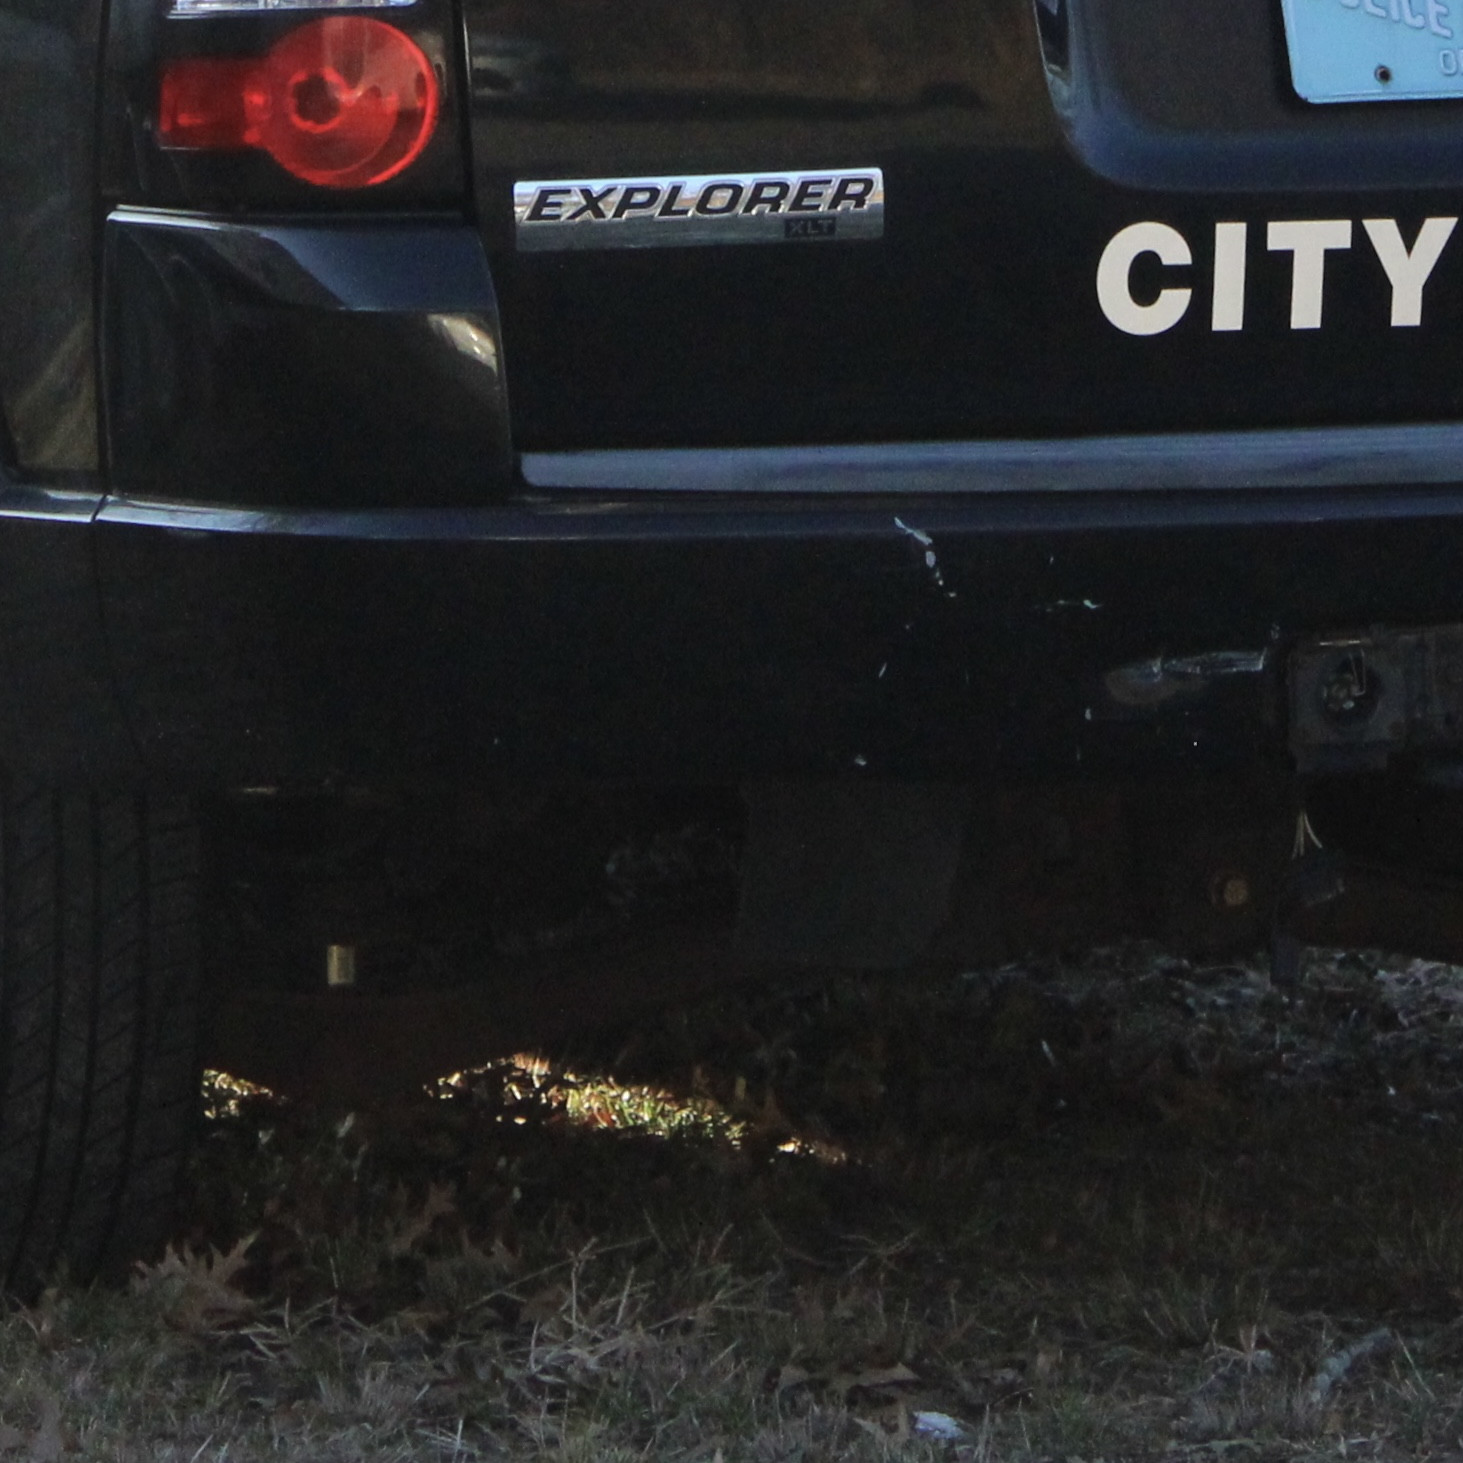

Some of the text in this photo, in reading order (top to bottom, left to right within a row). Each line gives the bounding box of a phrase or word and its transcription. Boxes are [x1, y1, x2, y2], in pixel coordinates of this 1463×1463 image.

[522, 174, 877, 222] EXPLORER
[788, 219, 834, 236] XLT
[1095, 217, 1459, 336] CITY
